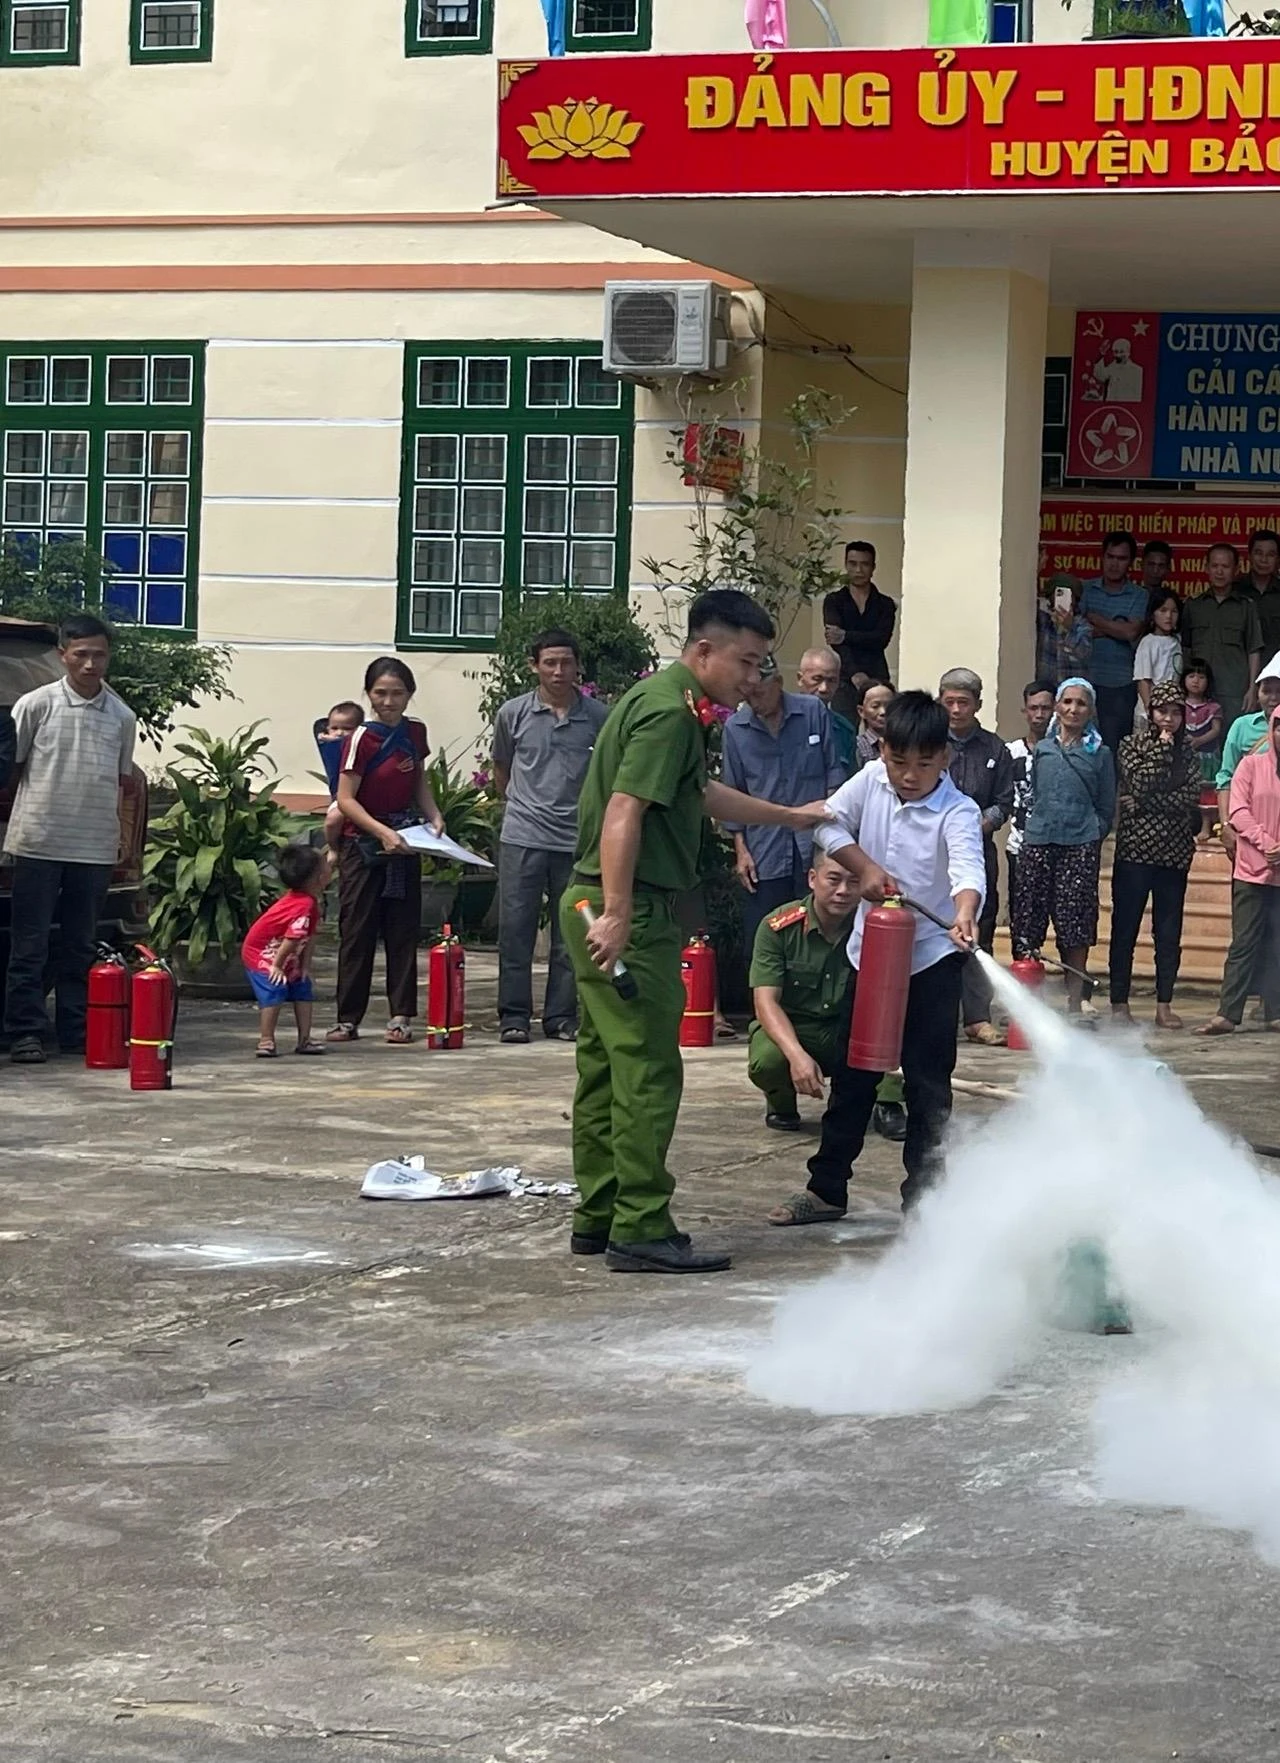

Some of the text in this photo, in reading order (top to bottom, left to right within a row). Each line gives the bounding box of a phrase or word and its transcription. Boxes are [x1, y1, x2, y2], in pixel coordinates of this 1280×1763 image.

[684, 53, 889, 129] ĐẢNG
[919, 50, 1017, 126] ỦY
[1036, 90, 1063, 102] -
[990, 130, 1169, 184] HUYỆN
[1166, 322, 1280, 353] CHUNG
[1187, 358, 1235, 395] CẢI
[1168, 401, 1248, 433] HÀNH
[1180, 442, 1241, 474] NHÀ
[1061, 510, 1094, 536] VIỆC
[1097, 514, 1134, 533] THEO
[1177, 511, 1217, 535] PHÁP
[1222, 513, 1241, 535] VÀ
